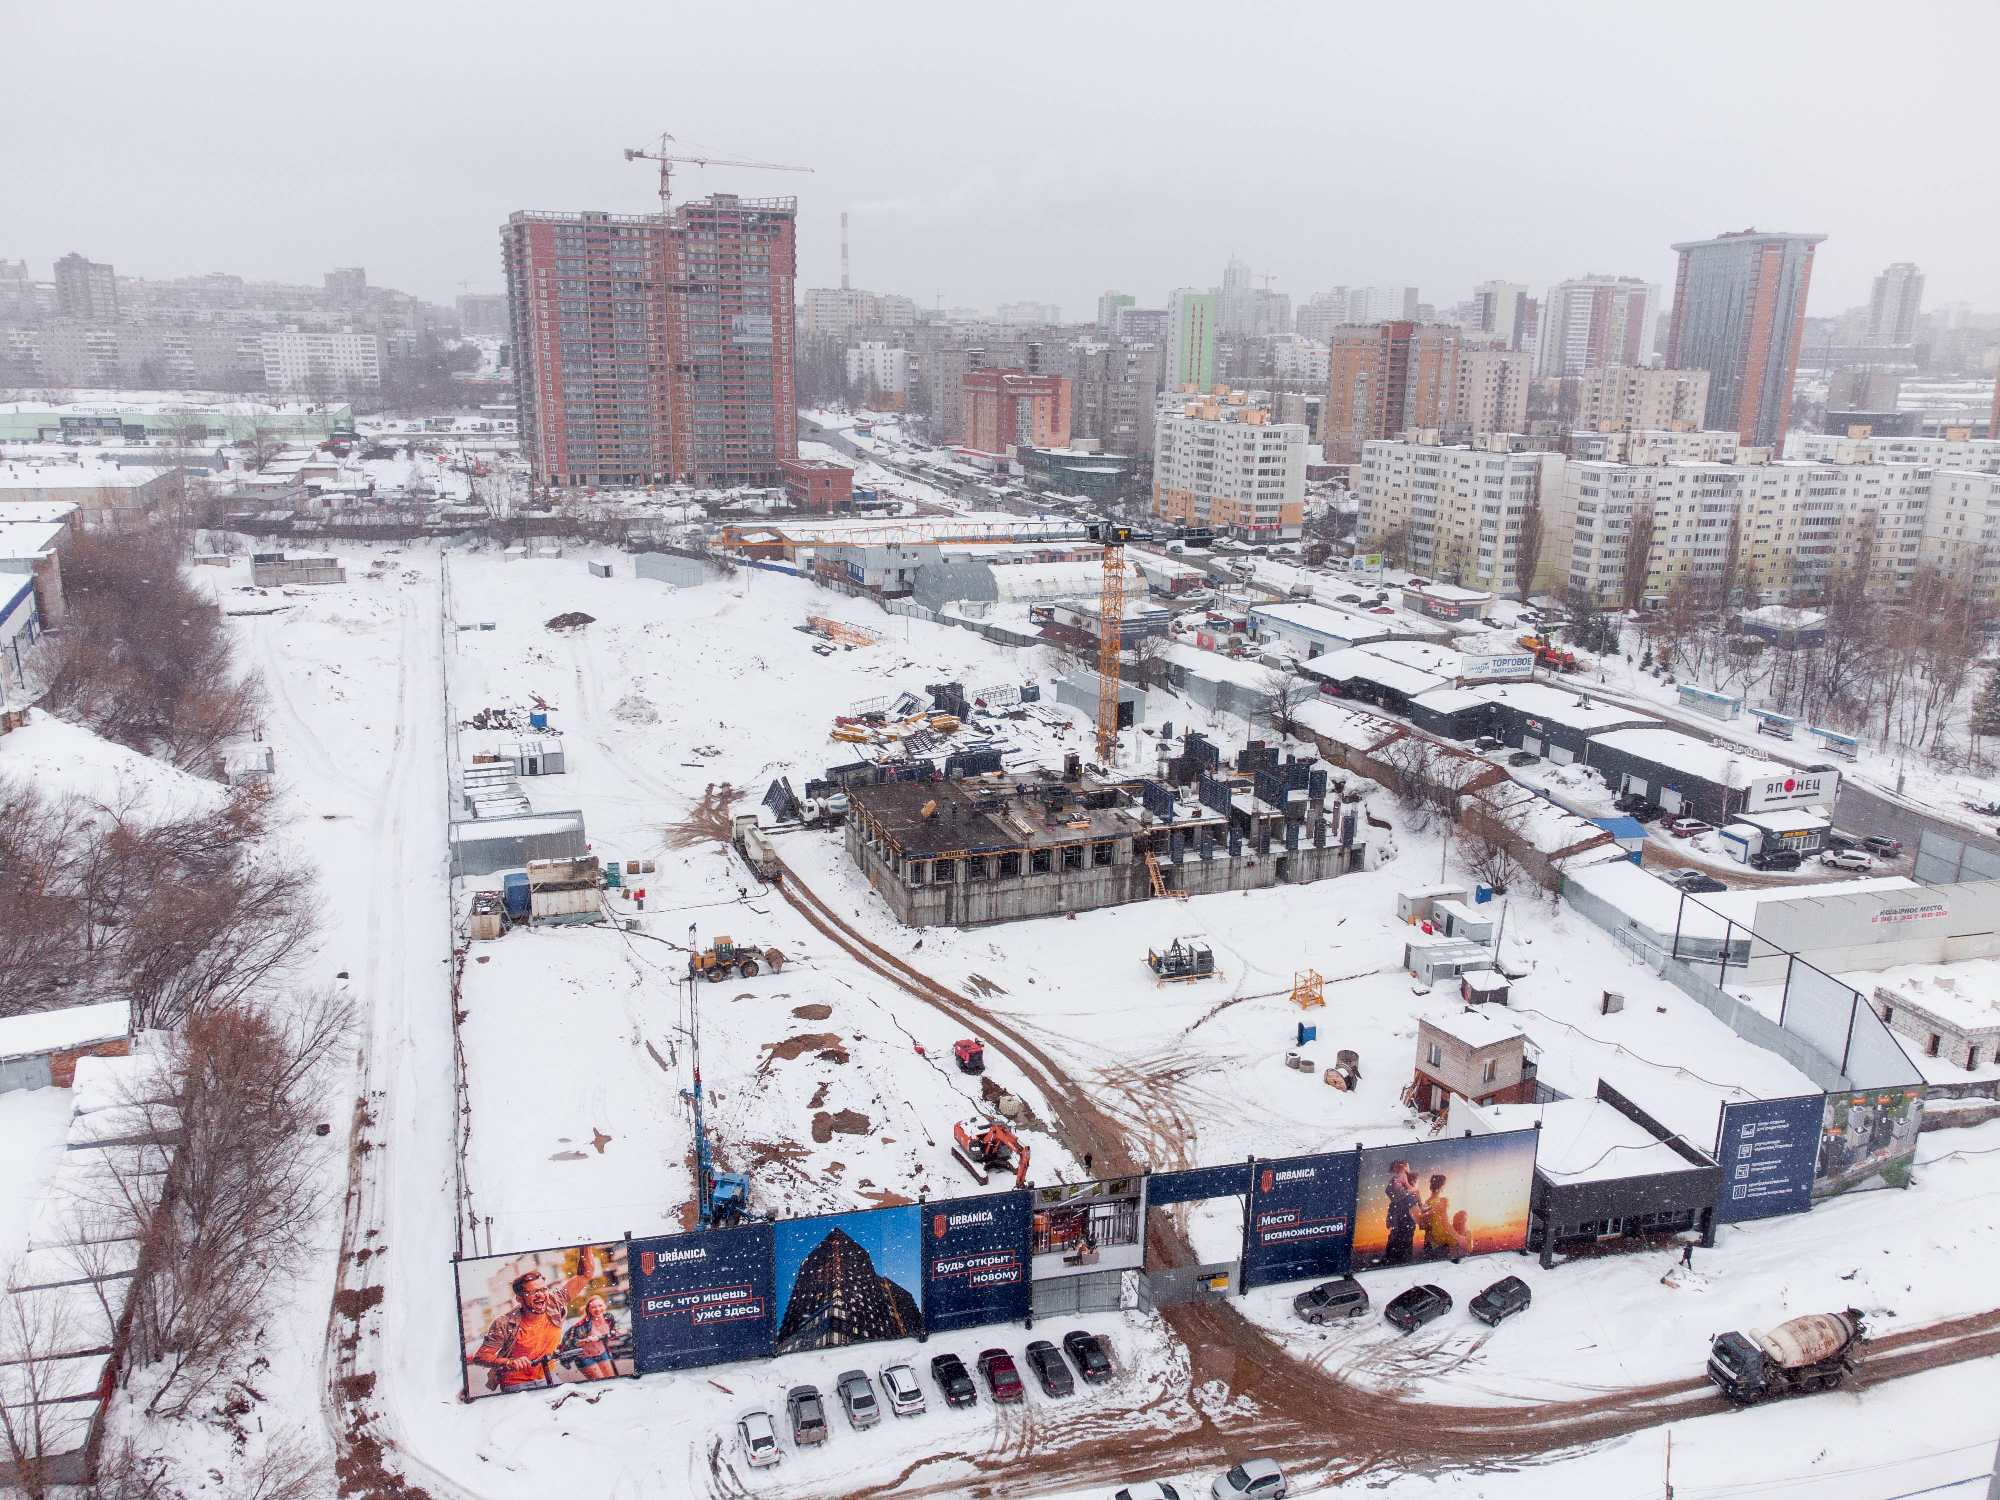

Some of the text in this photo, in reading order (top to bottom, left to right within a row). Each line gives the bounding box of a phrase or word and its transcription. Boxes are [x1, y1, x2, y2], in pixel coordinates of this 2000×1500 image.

[1492, 657, 1532, 667] ТОРГОВОЕ
[1275, 1168, 1315, 1181] URBANICA
[949, 1211, 993, 1225] URBANICA
[1261, 1214, 1295, 1226] Место
[1264, 1222, 1344, 1241] возможностей
[658, 1248, 706, 1262] URBANICA
[937, 1255, 1010, 1273] Будь открыт
[973, 1270, 1018, 1283] новому
[647, 1290, 748, 1311] Все, что ищешь
[696, 1304, 760, 1322] уже здесь
